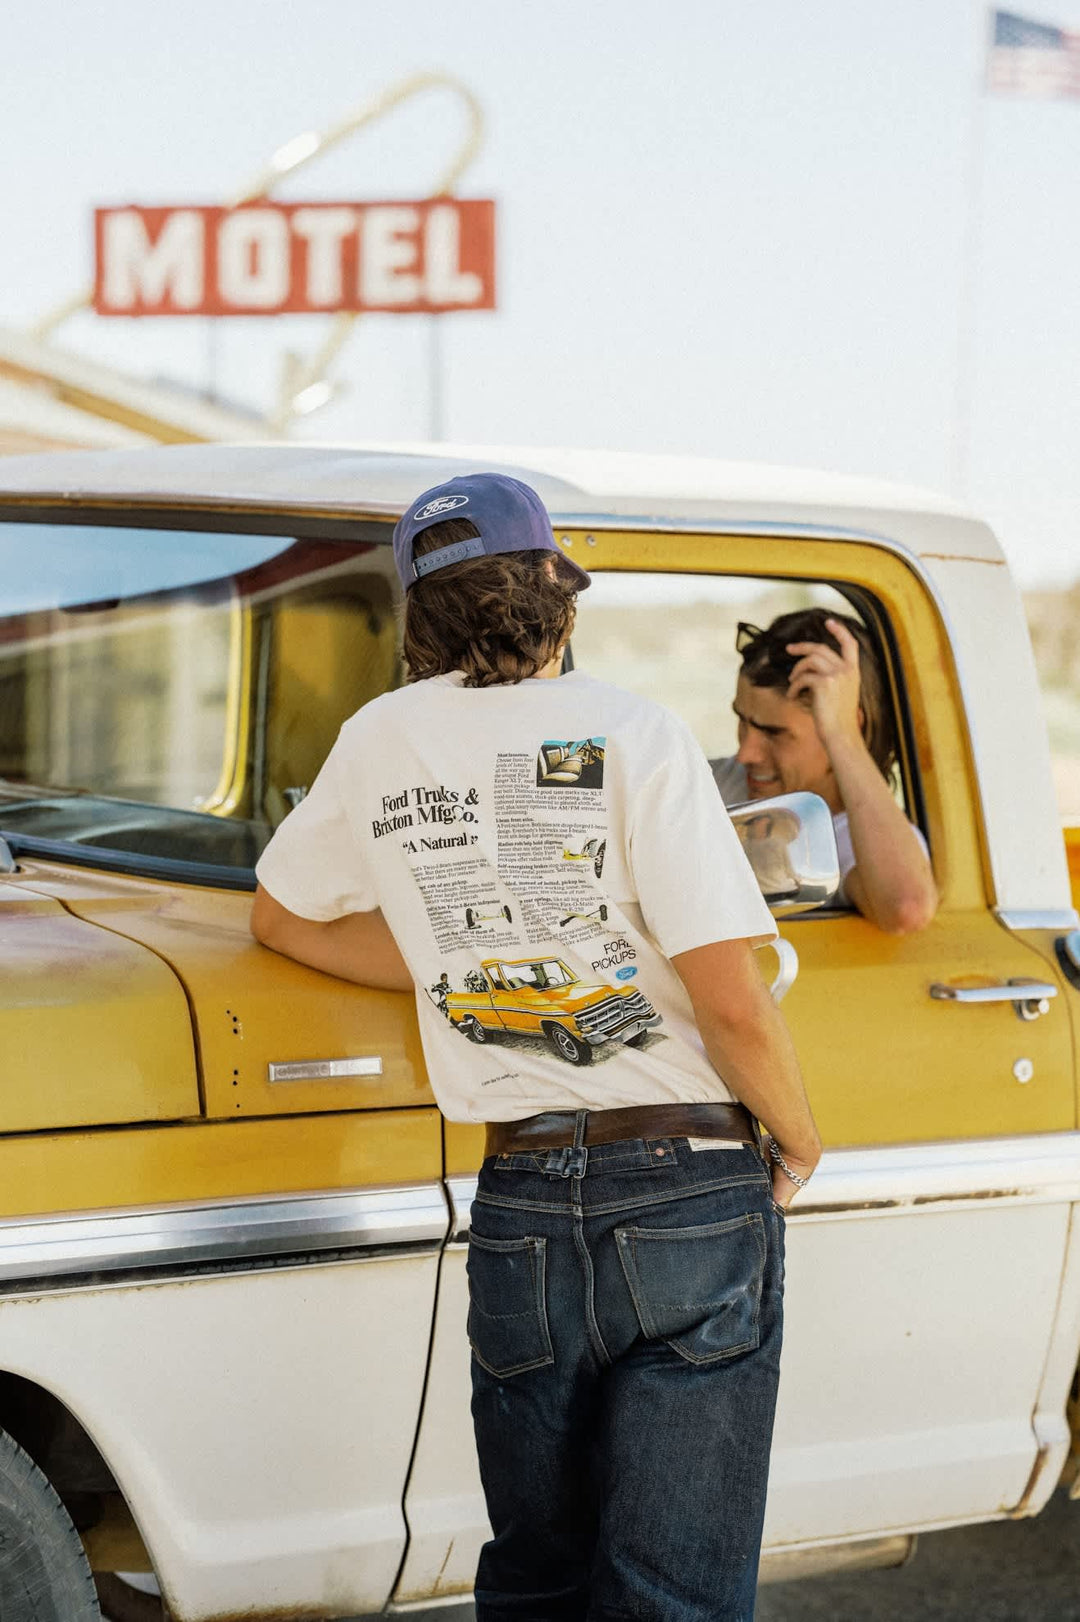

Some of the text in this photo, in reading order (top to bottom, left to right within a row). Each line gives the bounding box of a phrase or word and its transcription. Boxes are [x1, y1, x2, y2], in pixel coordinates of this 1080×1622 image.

[103, 205, 484, 308] MOTEL
[423, 498, 457, 516] Ford
[382, 785, 479, 814] Ford Truks &
[372, 814, 413, 839] Brixton
[420, 832, 468, 852] Natural
[591, 949, 637, 972] PICKUPS
